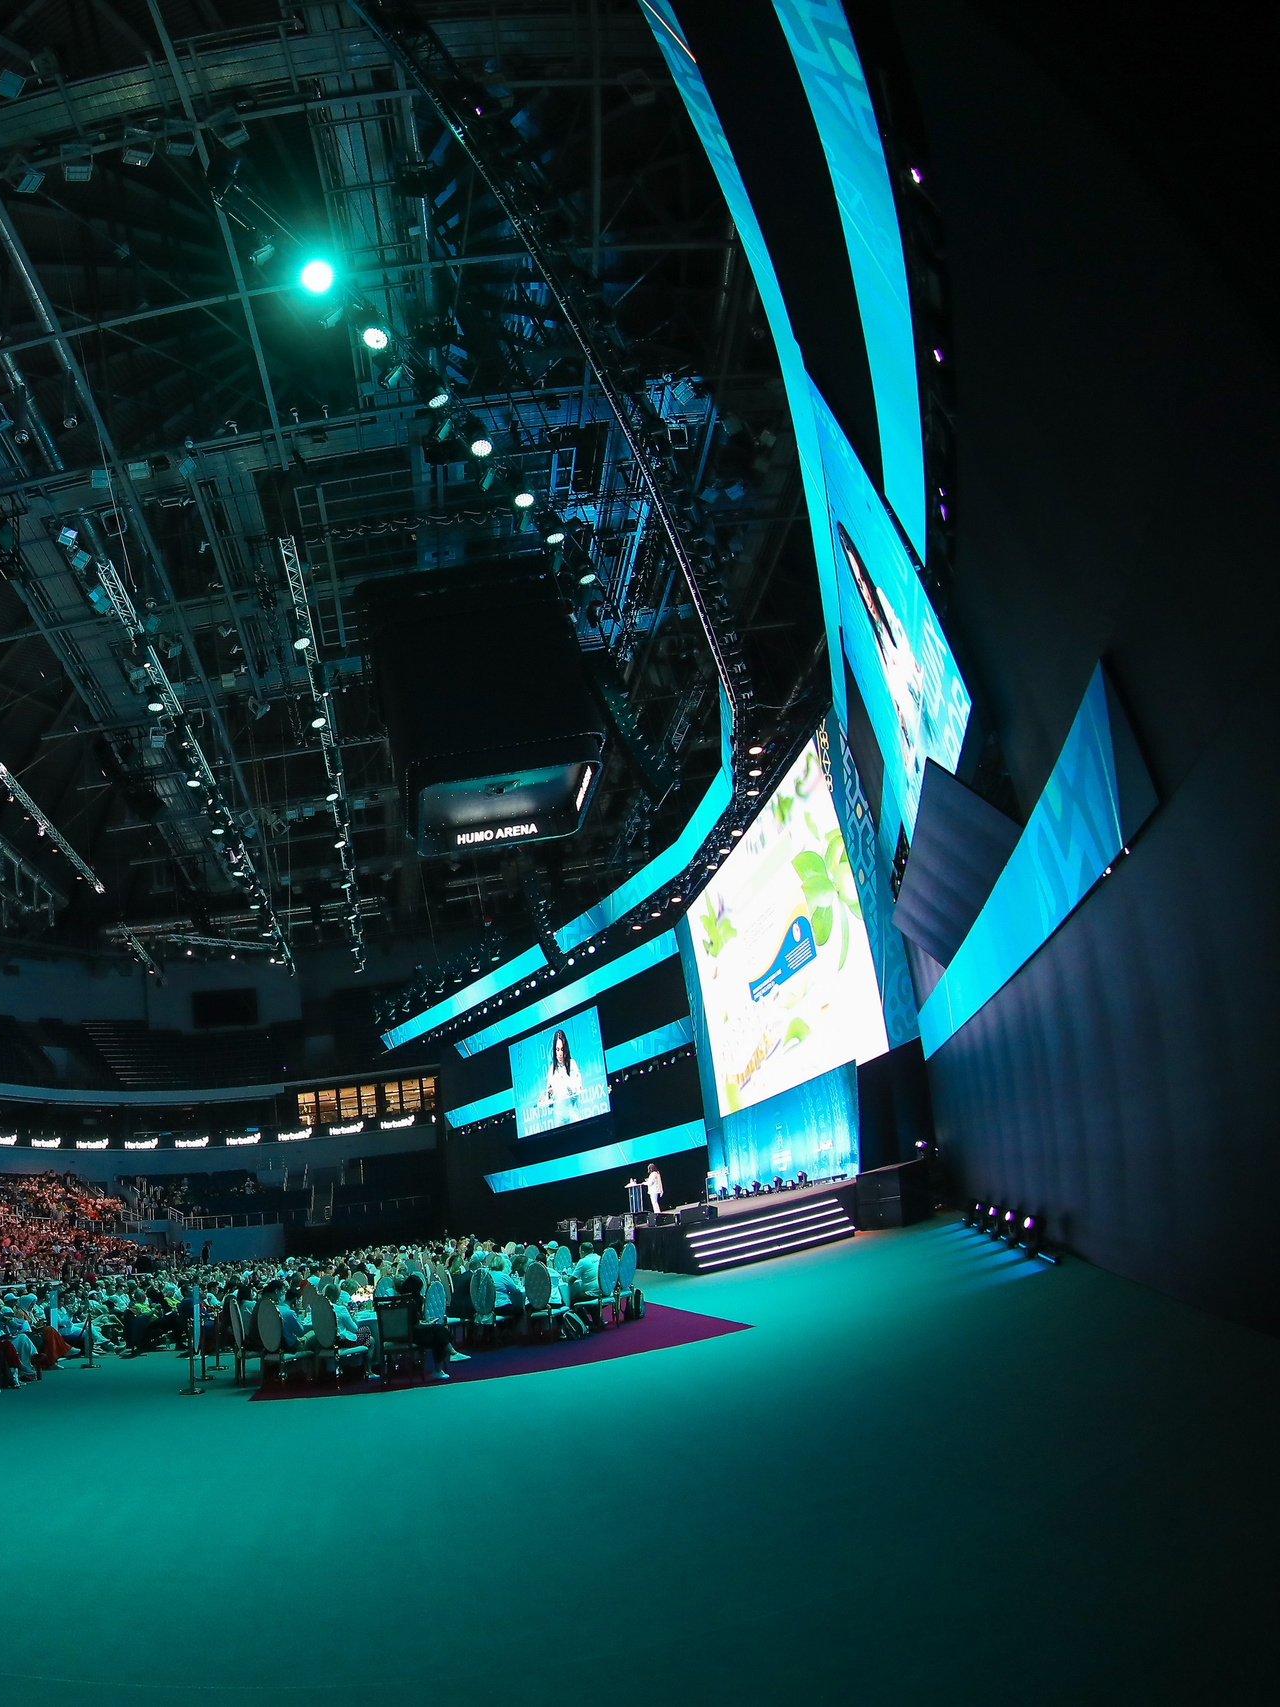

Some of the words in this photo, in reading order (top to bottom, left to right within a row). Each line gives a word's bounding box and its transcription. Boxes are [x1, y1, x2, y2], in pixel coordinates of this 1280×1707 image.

[921, 602, 948, 720] ЩИХ
[456, 829, 494, 846] HUMO
[495, 822, 539, 840] ARENA
